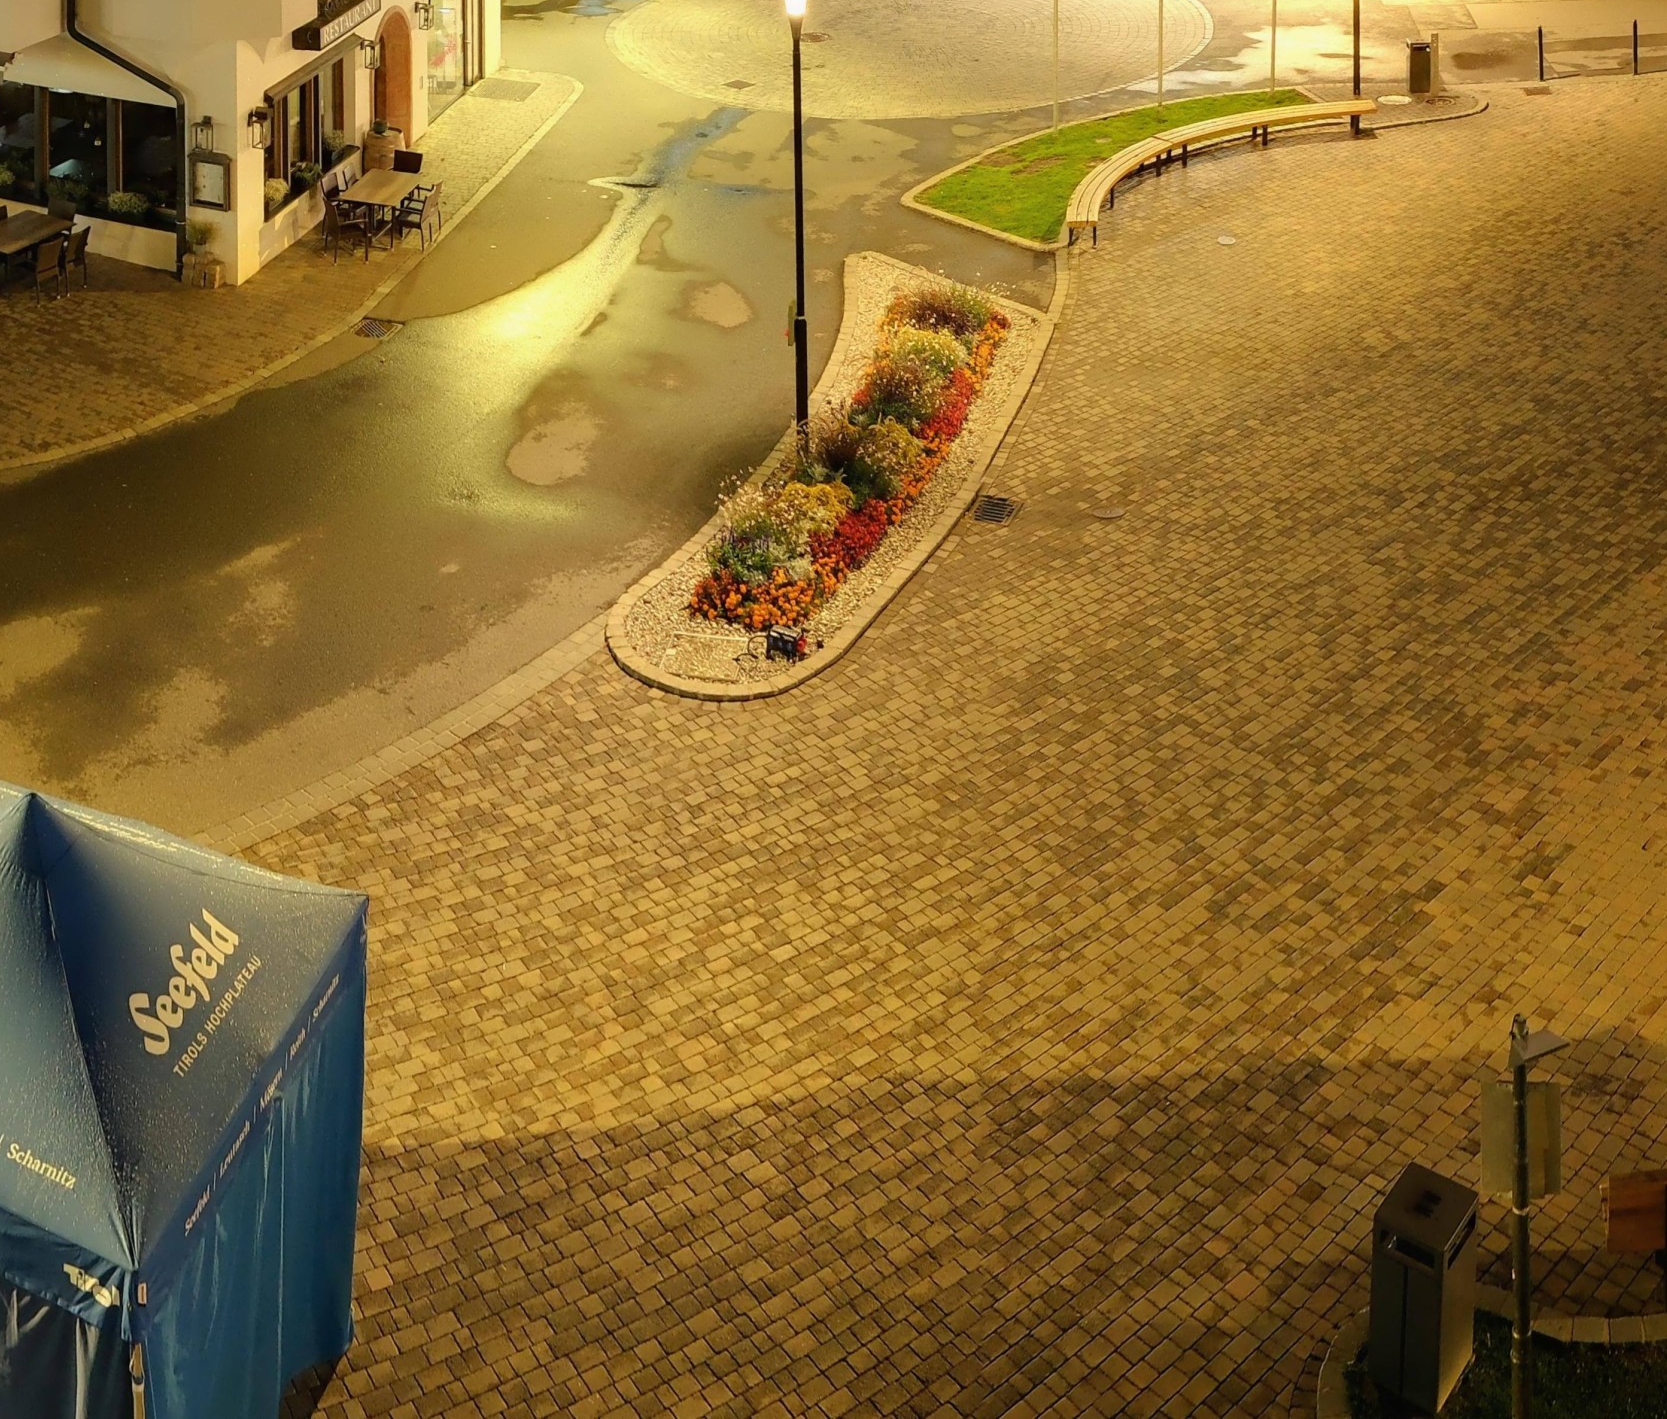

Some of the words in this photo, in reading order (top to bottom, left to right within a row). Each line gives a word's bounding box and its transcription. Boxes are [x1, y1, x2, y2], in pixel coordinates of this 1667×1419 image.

[128, 907, 239, 1056] Seefeld
[172, 1032, 208, 1078] TIROLS
[204, 955, 262, 1033] HOCHPLATEAU
[5, 1142, 77, 1190] Scharnitz
[184, 1184, 211, 1237] Seefeld
[219, 1120, 251, 1179] Leutasch
[259, 1069, 283, 1113] Mösern
[312, 973, 340, 1023] Scharnitz
